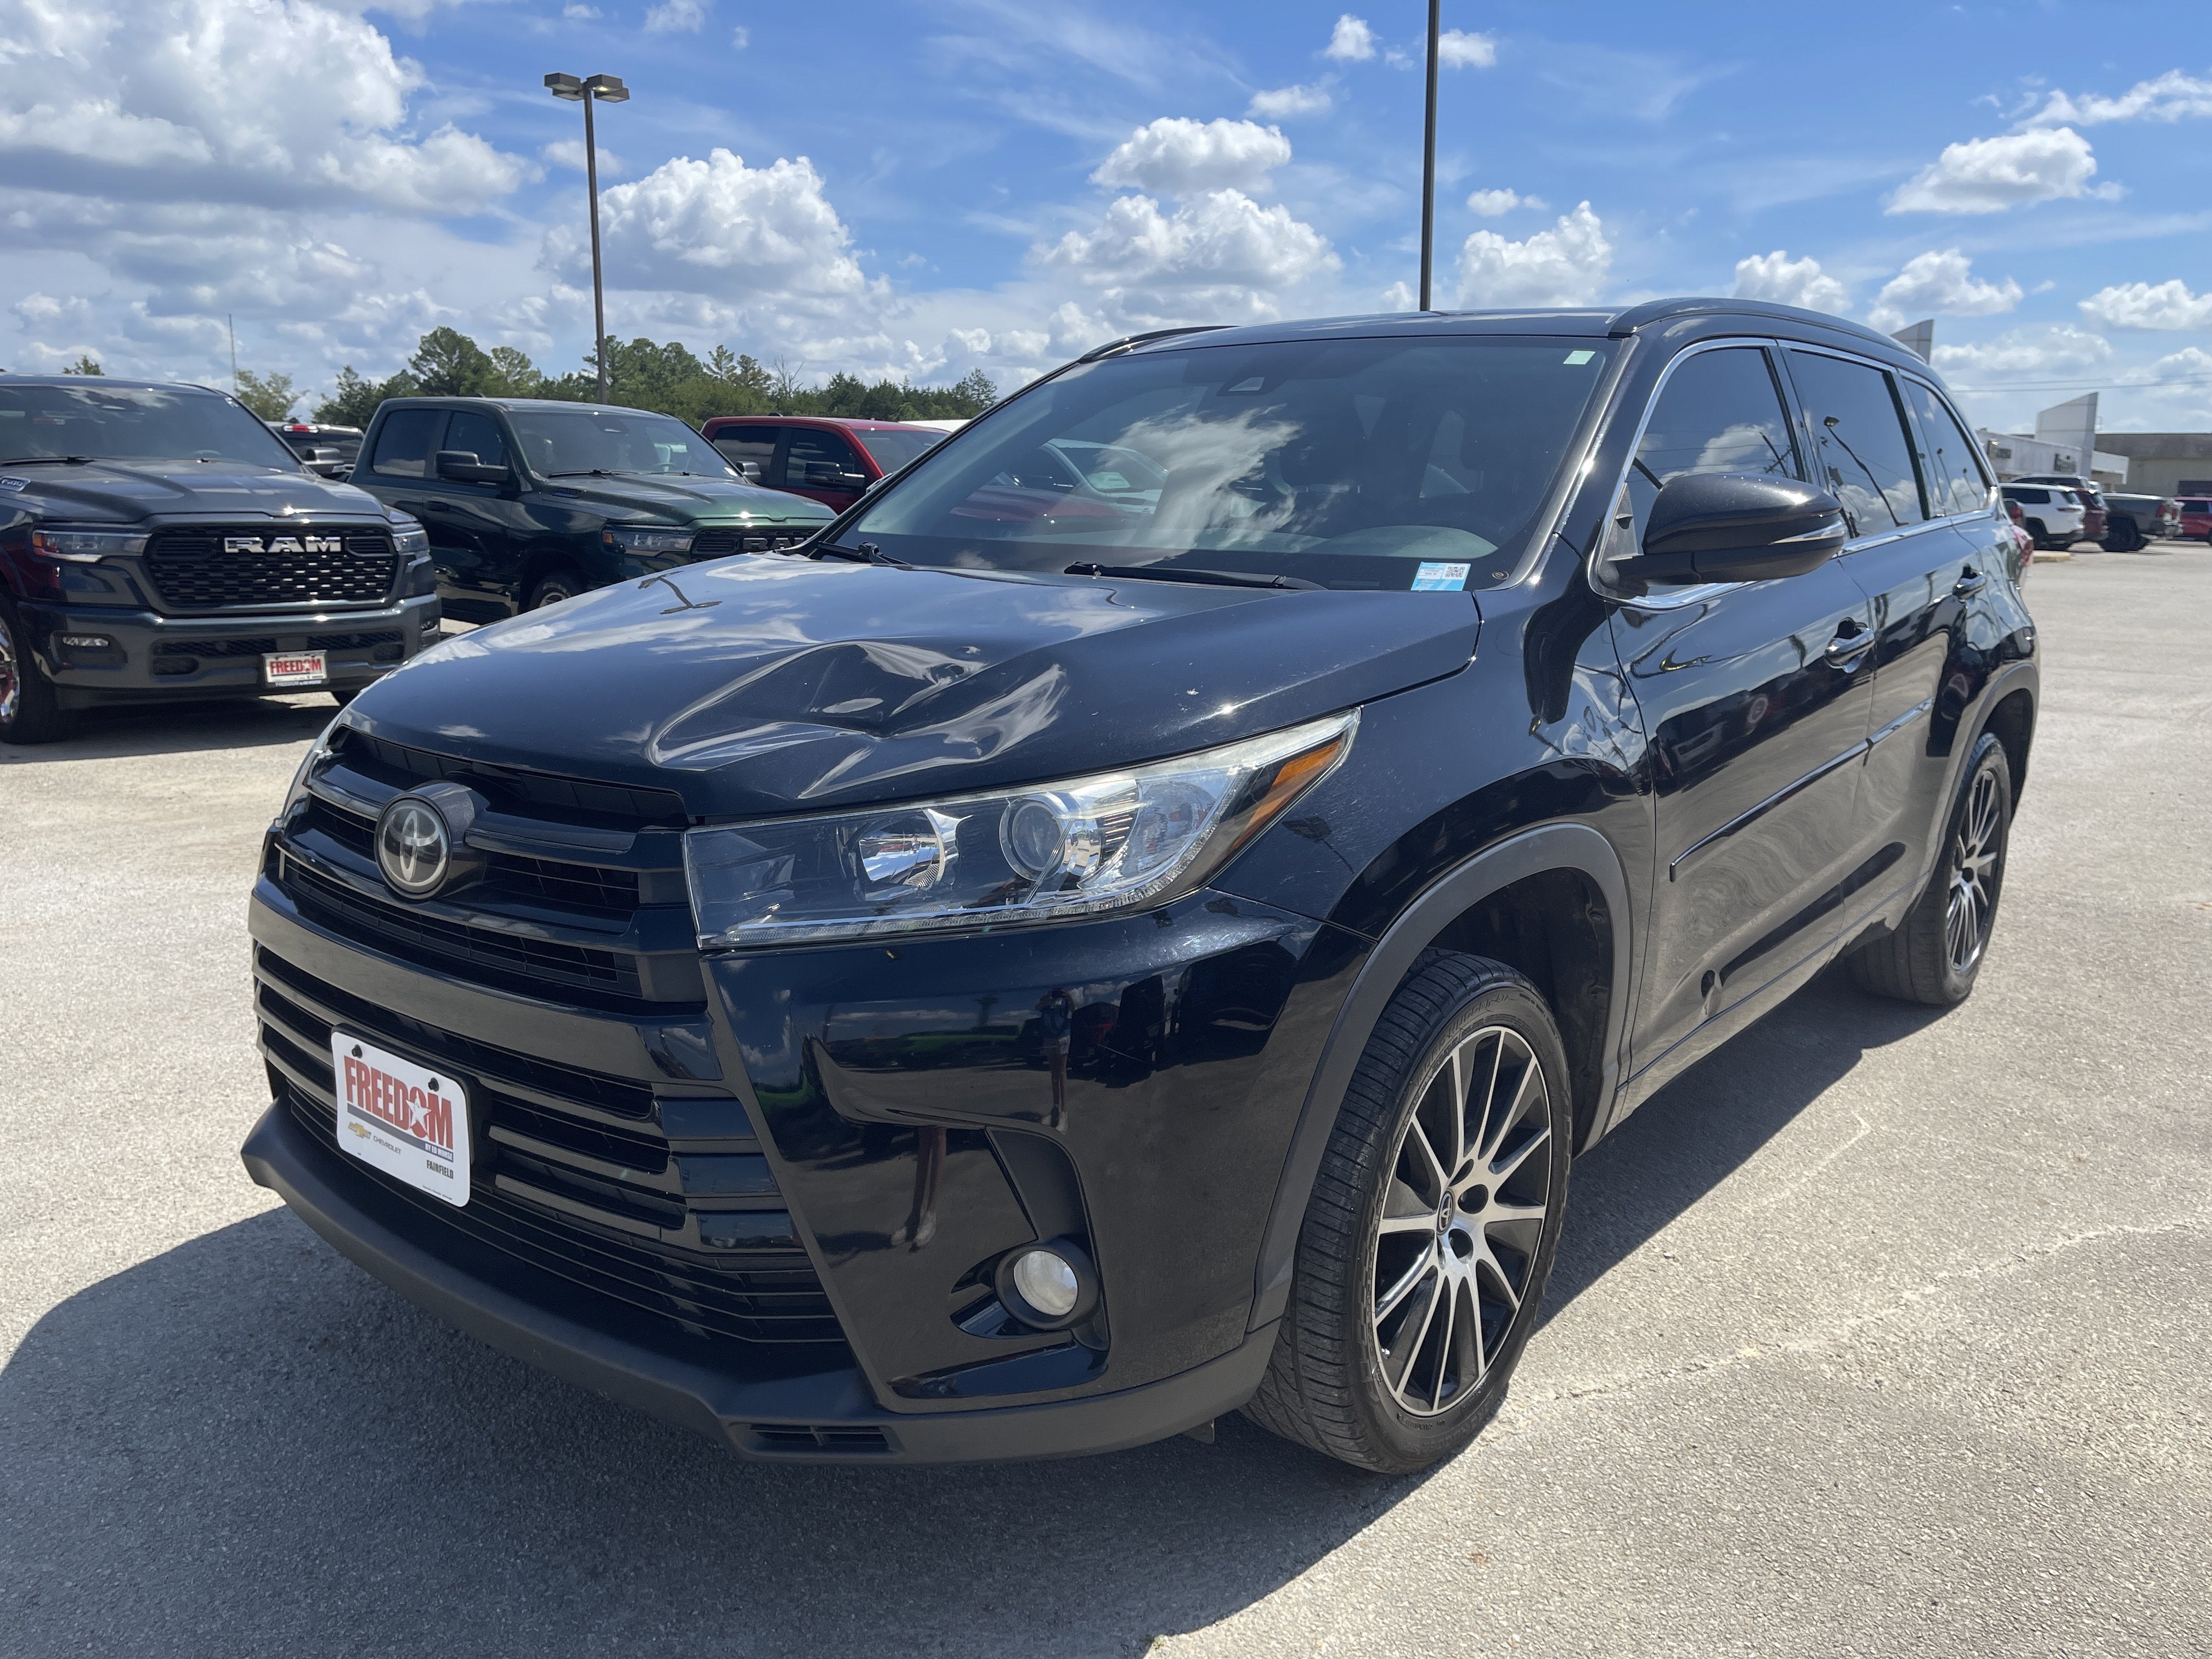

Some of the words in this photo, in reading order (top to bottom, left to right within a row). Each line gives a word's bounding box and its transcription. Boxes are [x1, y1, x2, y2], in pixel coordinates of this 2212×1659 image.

[224, 537, 341, 553] RAM
[270, 658, 322, 674] FREEDOM
[343, 1055, 453, 1150] FREEDOM
[373, 1136, 401, 1155] CHEVROLET
[426, 1160, 454, 1179] FAIRFIELD
